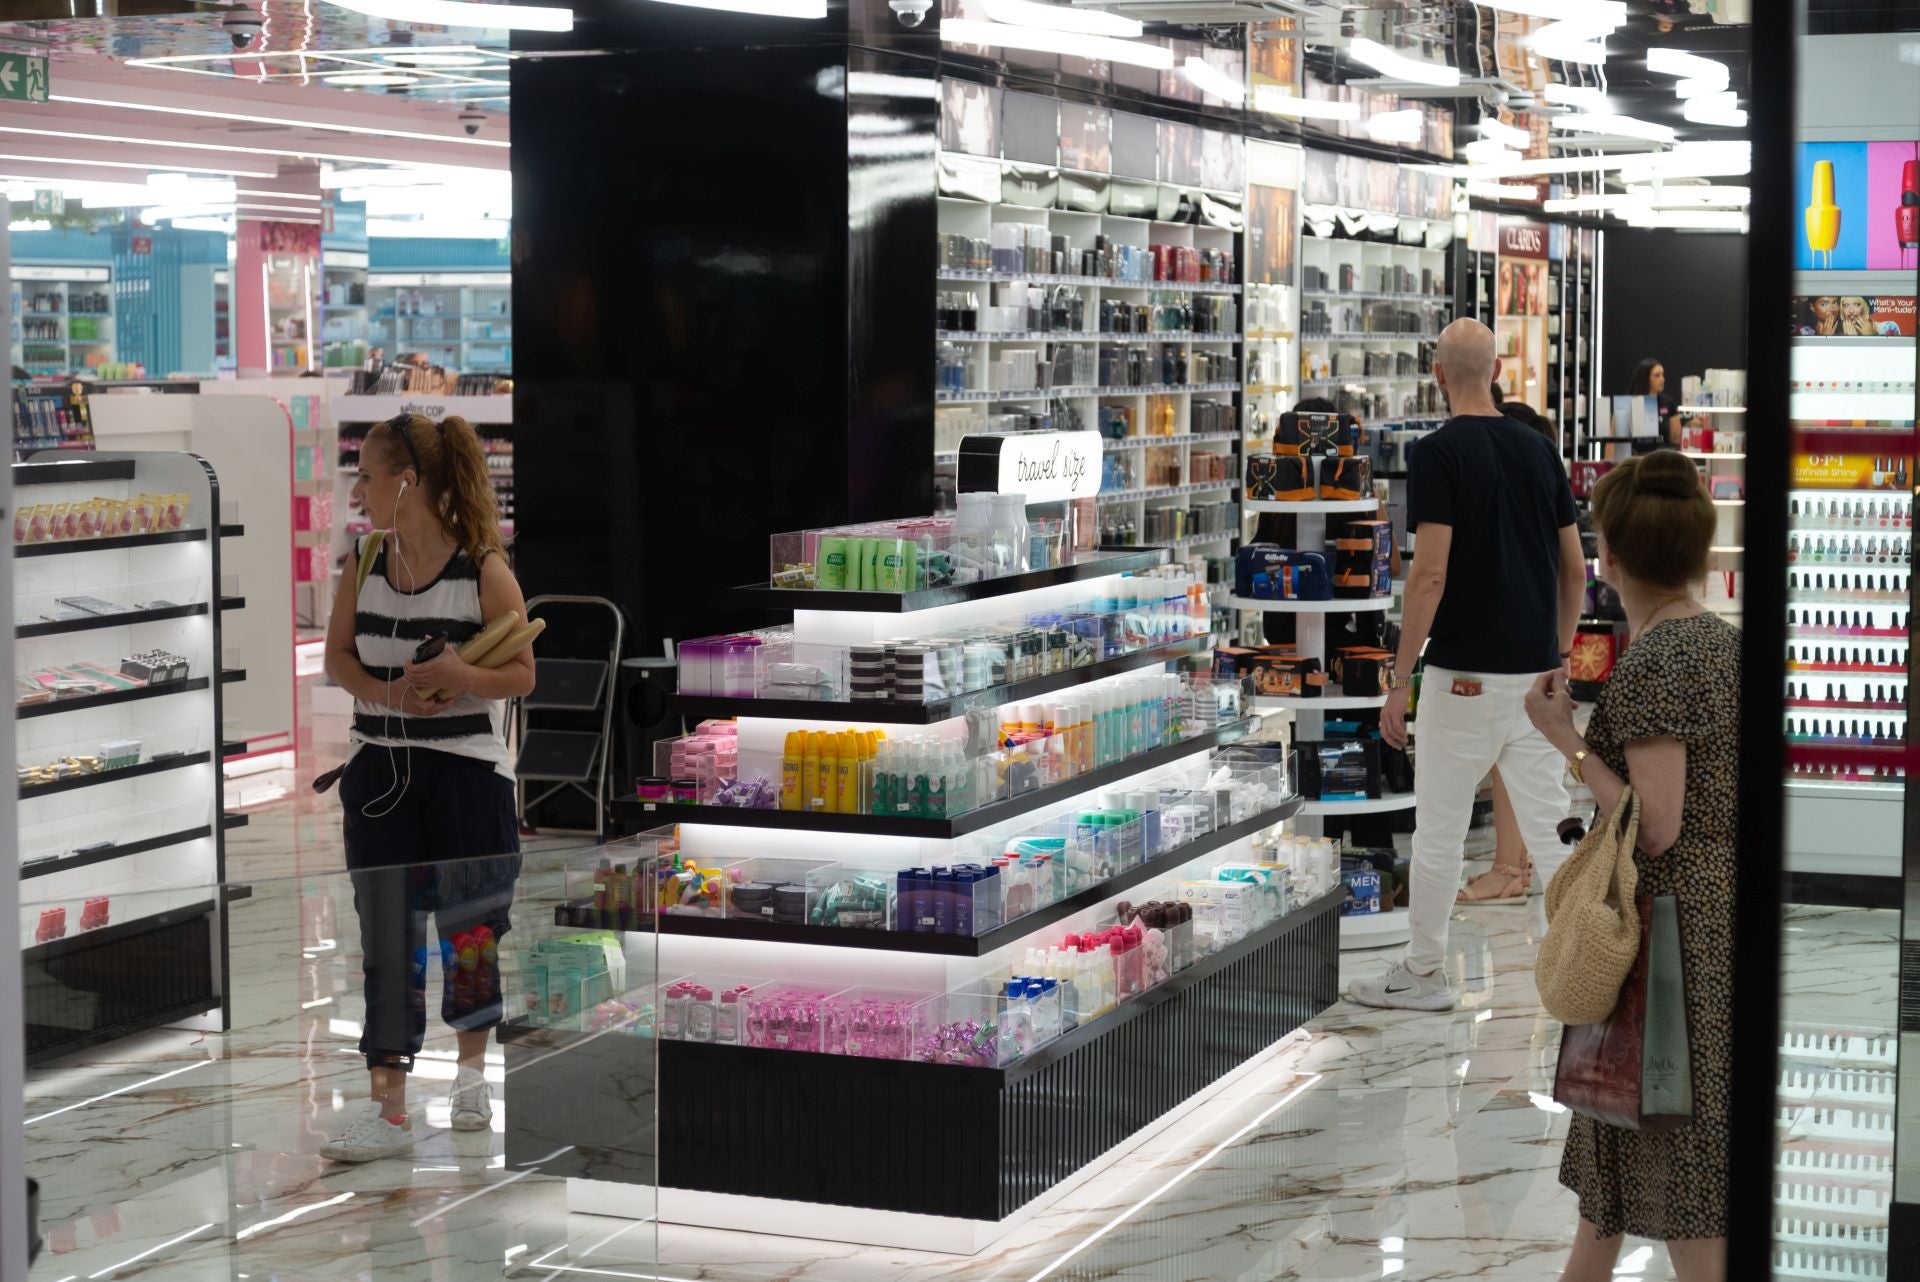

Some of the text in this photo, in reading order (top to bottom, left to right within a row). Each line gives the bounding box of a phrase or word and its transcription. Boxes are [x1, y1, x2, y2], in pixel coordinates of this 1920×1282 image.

[1506, 227, 1541, 252] CLARINS
[1869, 298, 1914, 307] What's Your
[1873, 306, 1917, 314] Mani-tude?
[425, 405, 446, 417] COP
[1018, 440, 1086, 492] travel size
[1794, 467, 1858, 477] Infinite Shine
[1264, 553, 1289, 562] Gillette
[1351, 875, 1380, 888] MEN
